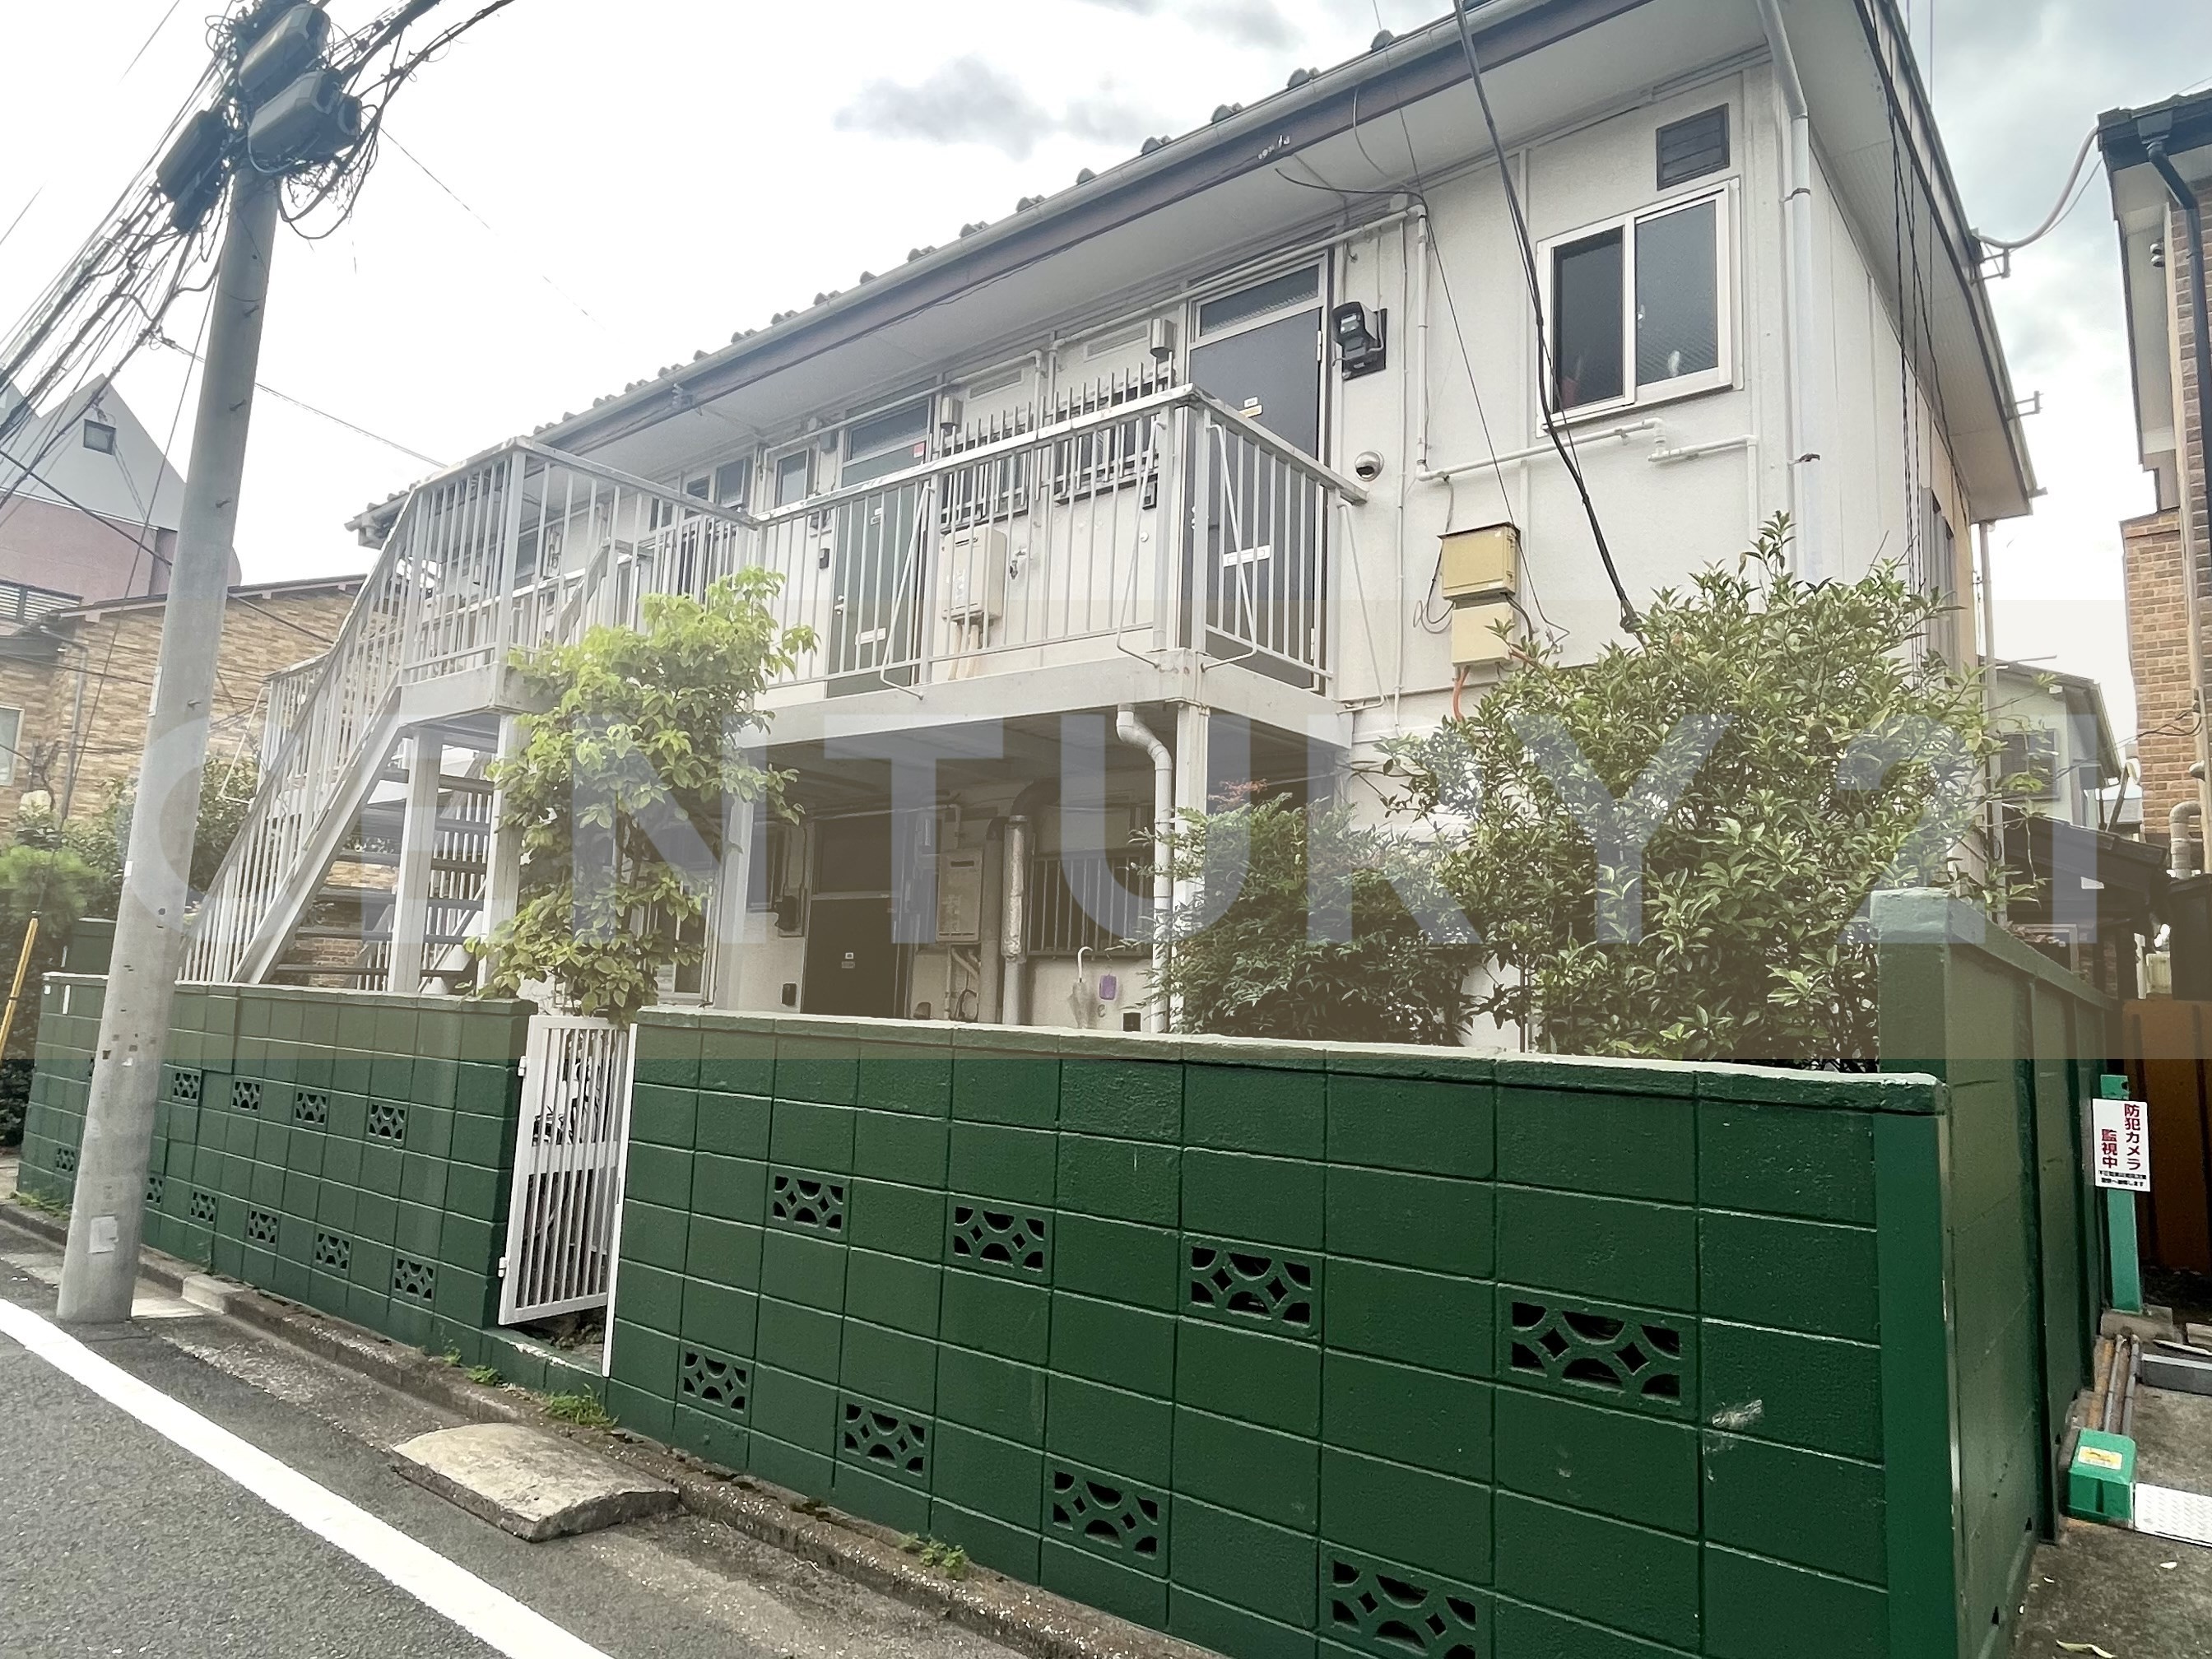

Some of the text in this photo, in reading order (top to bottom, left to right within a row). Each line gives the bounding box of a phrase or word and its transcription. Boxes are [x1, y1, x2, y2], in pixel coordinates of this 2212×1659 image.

[2101, 1128, 2118, 1169] 監視中
[2124, 1104, 2141, 1170] 防犯カメラ
